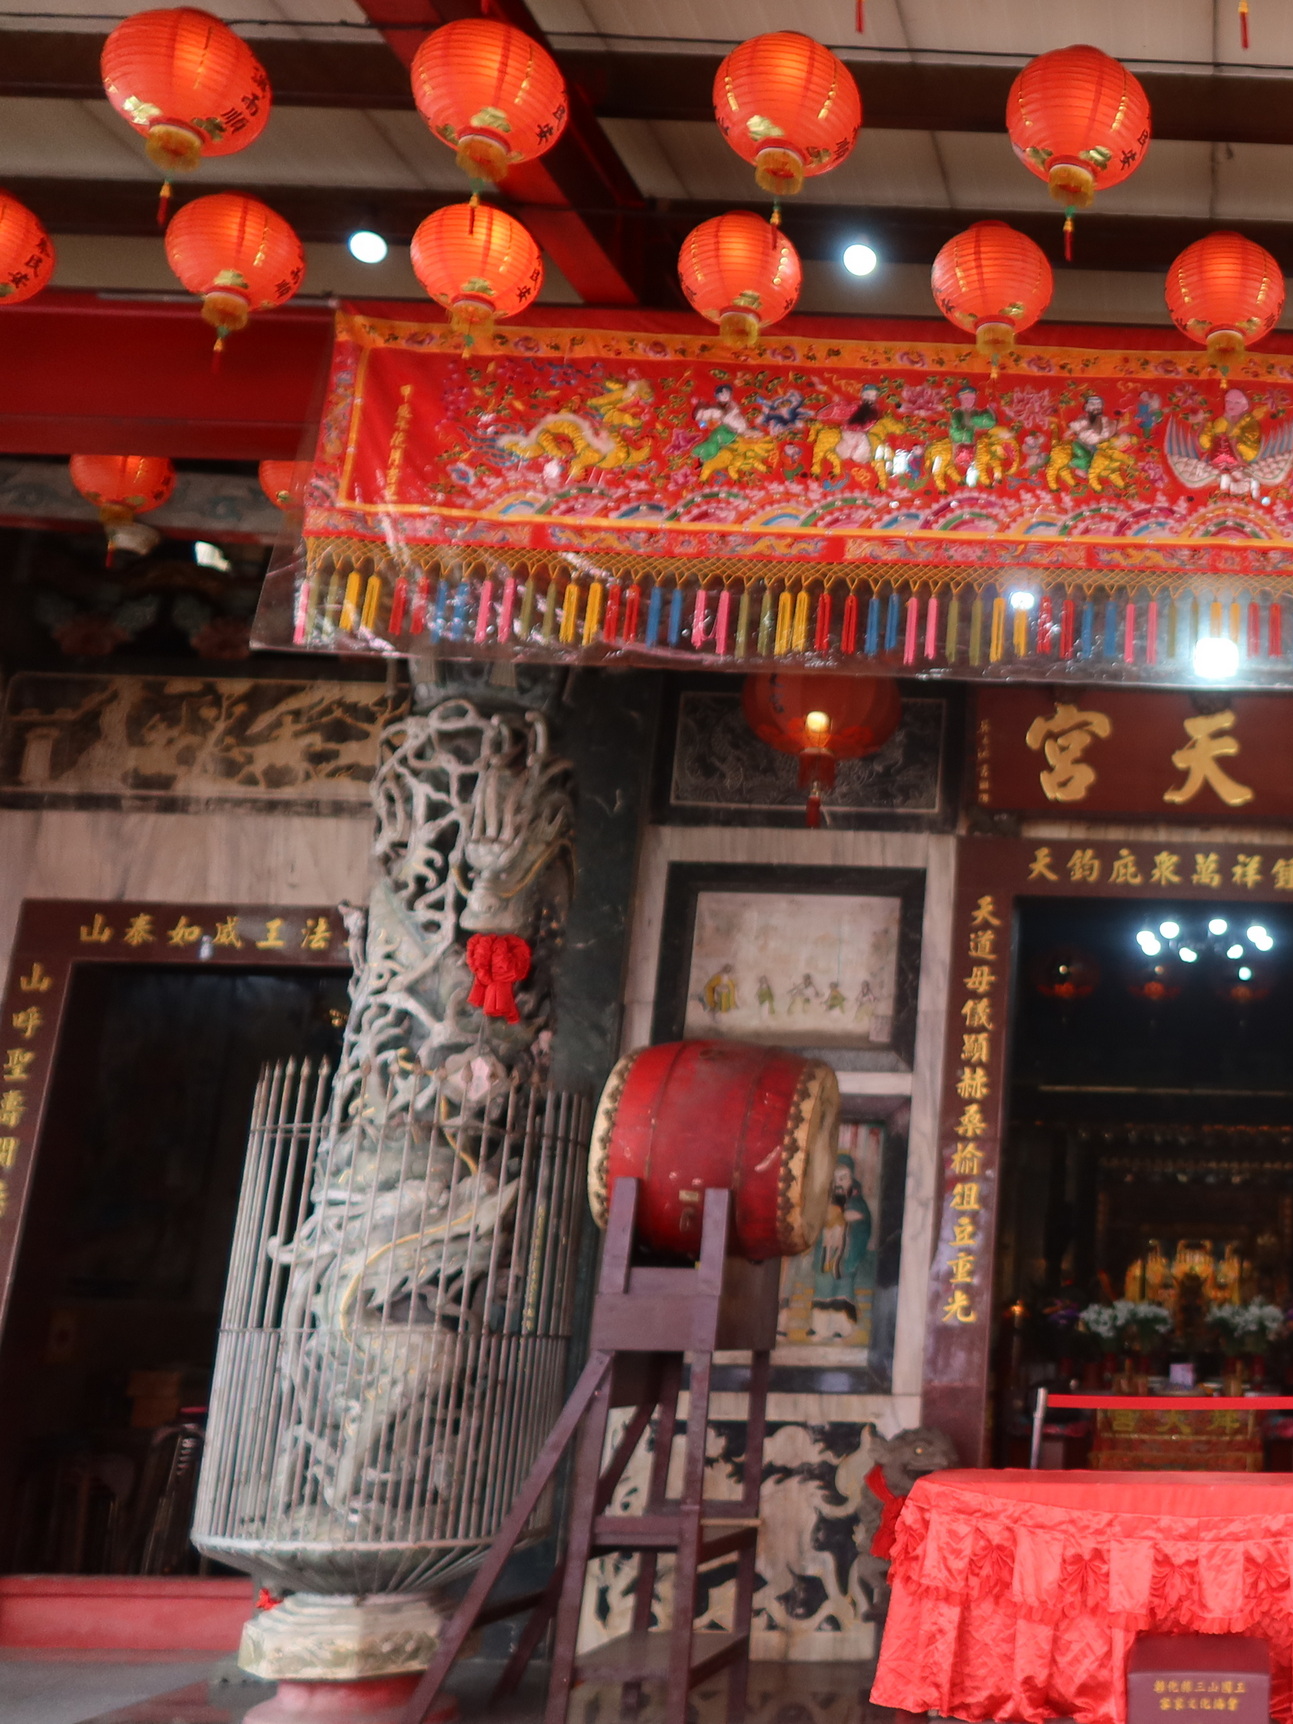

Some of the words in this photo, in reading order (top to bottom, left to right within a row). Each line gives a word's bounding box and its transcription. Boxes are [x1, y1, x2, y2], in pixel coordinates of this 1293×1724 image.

[80, 912, 352, 949] 法王威如泰山
